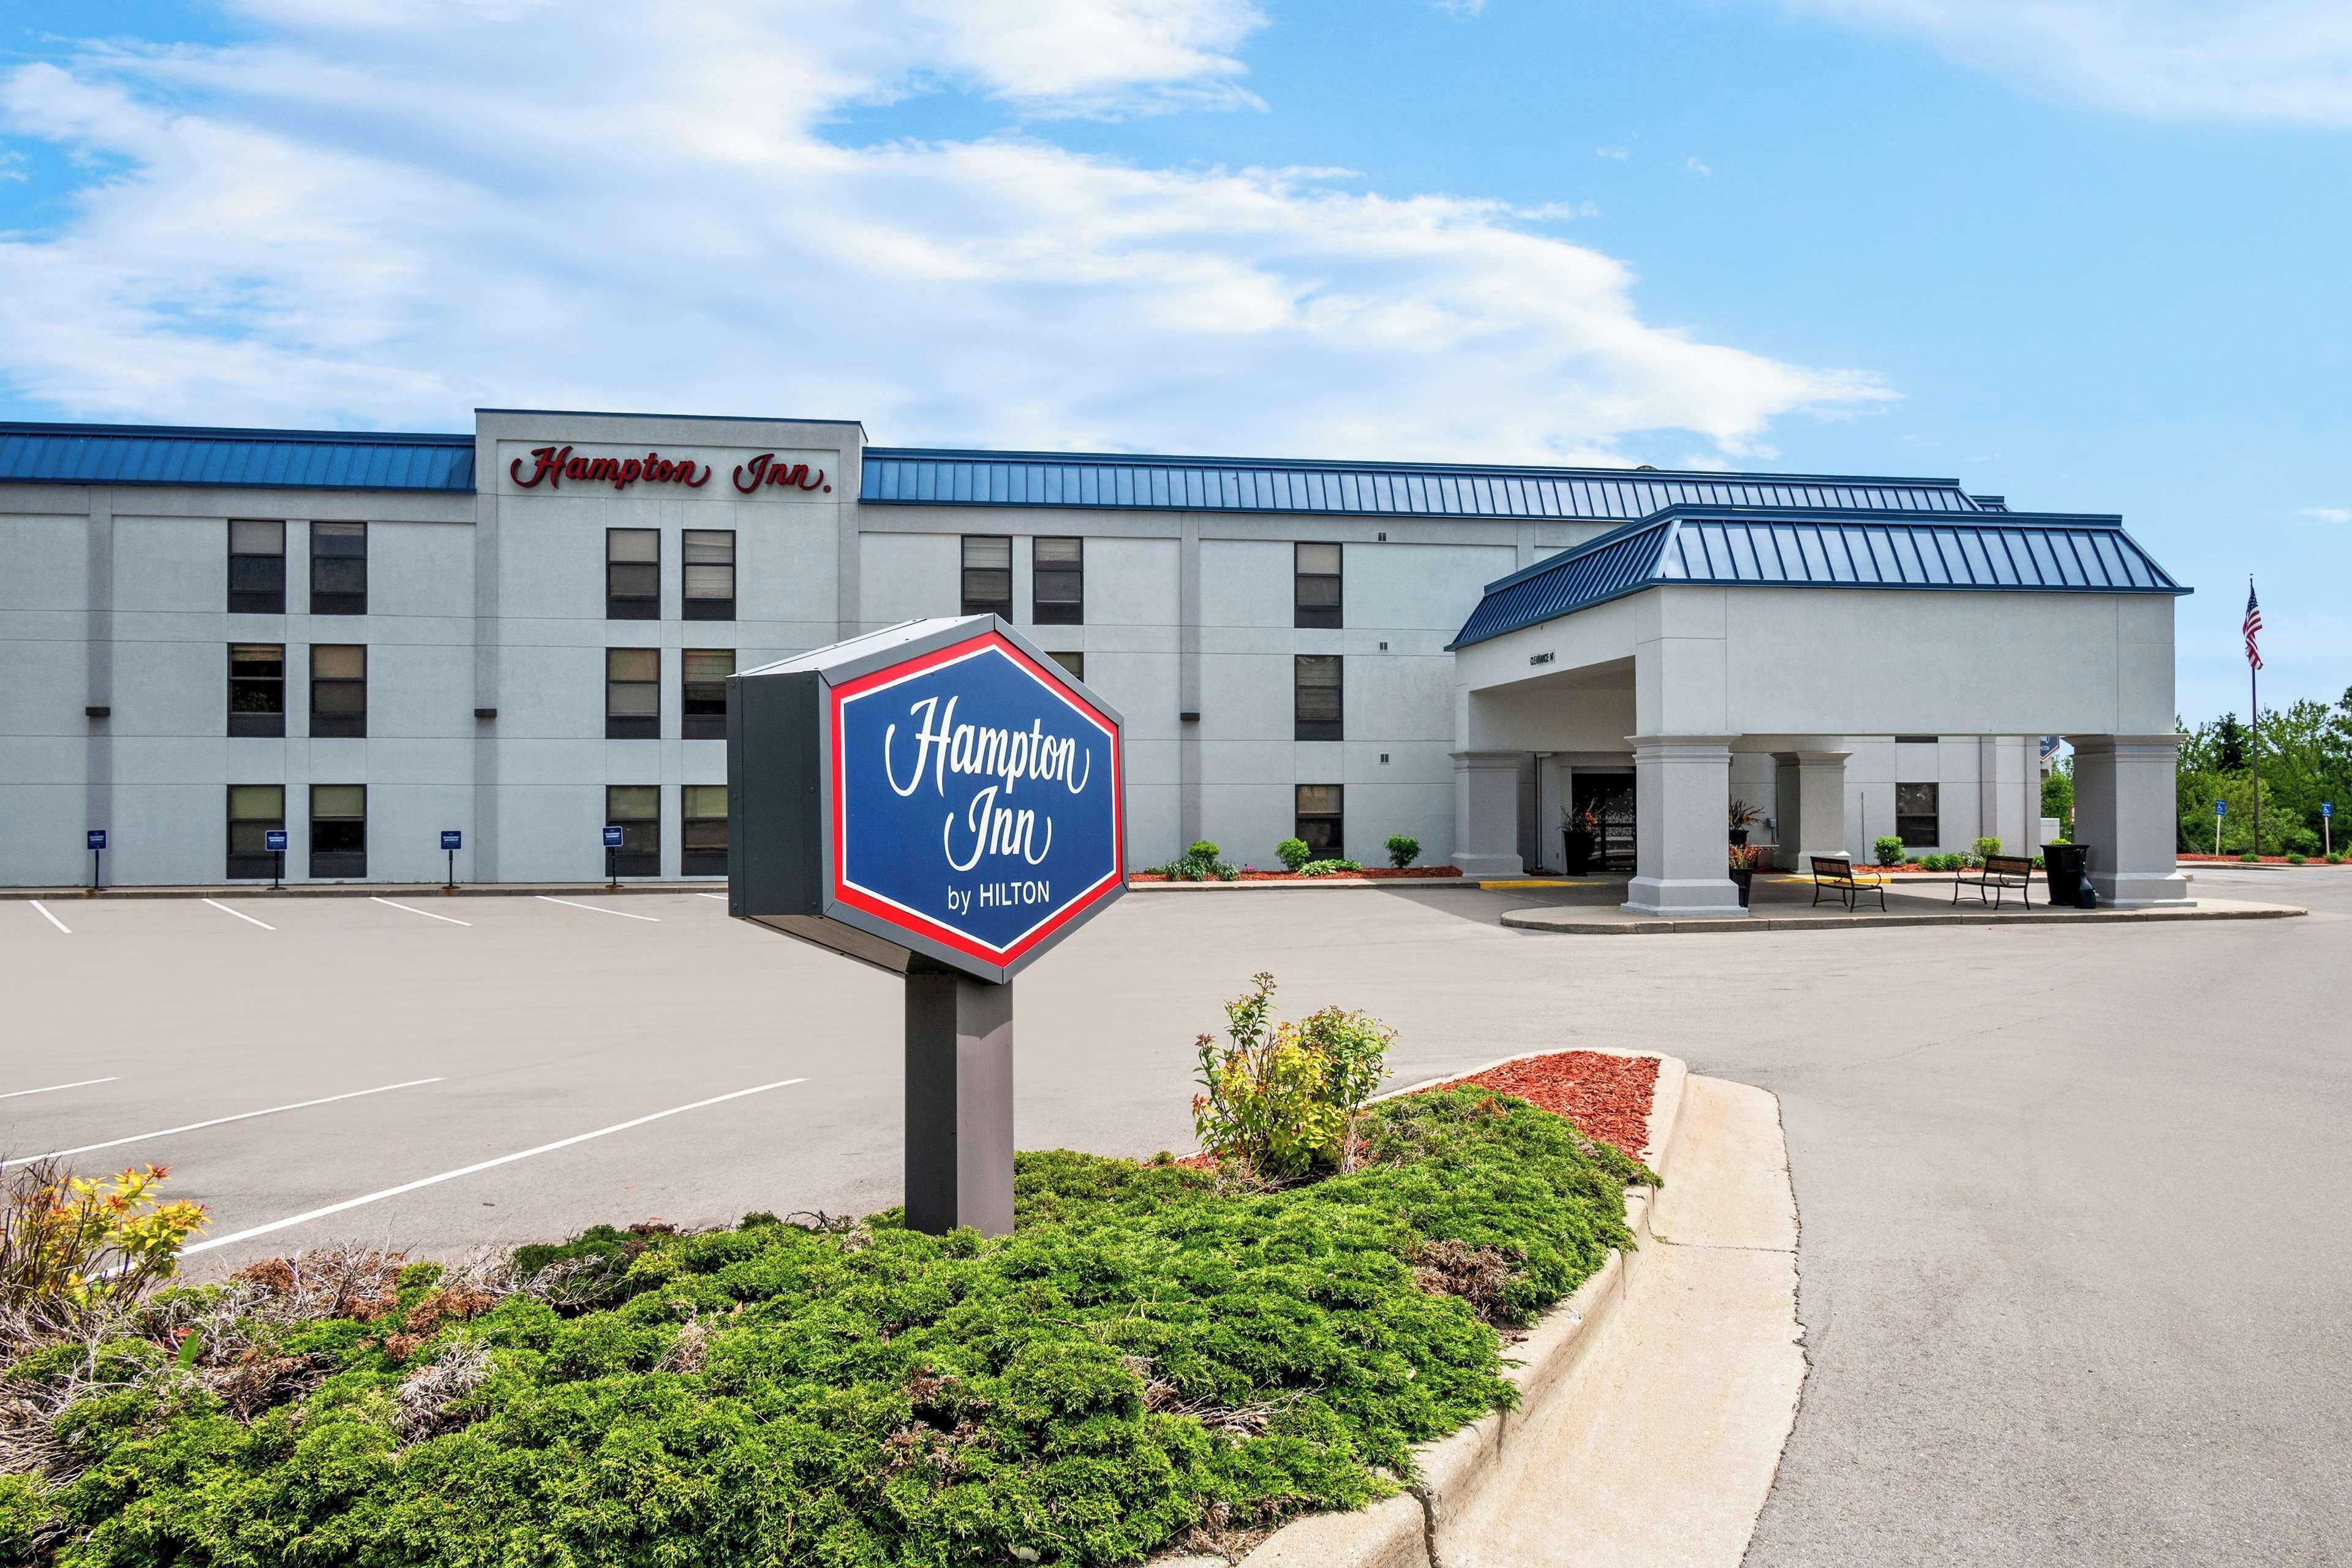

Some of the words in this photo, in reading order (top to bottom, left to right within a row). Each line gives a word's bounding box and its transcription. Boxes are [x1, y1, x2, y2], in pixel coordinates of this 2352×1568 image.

[510, 445, 710, 489] Hampton
[884, 695, 1090, 797] Hampton
[944, 785, 1052, 872] Inn
[948, 885, 971, 916] by
[980, 881, 1050, 907] HILTON
